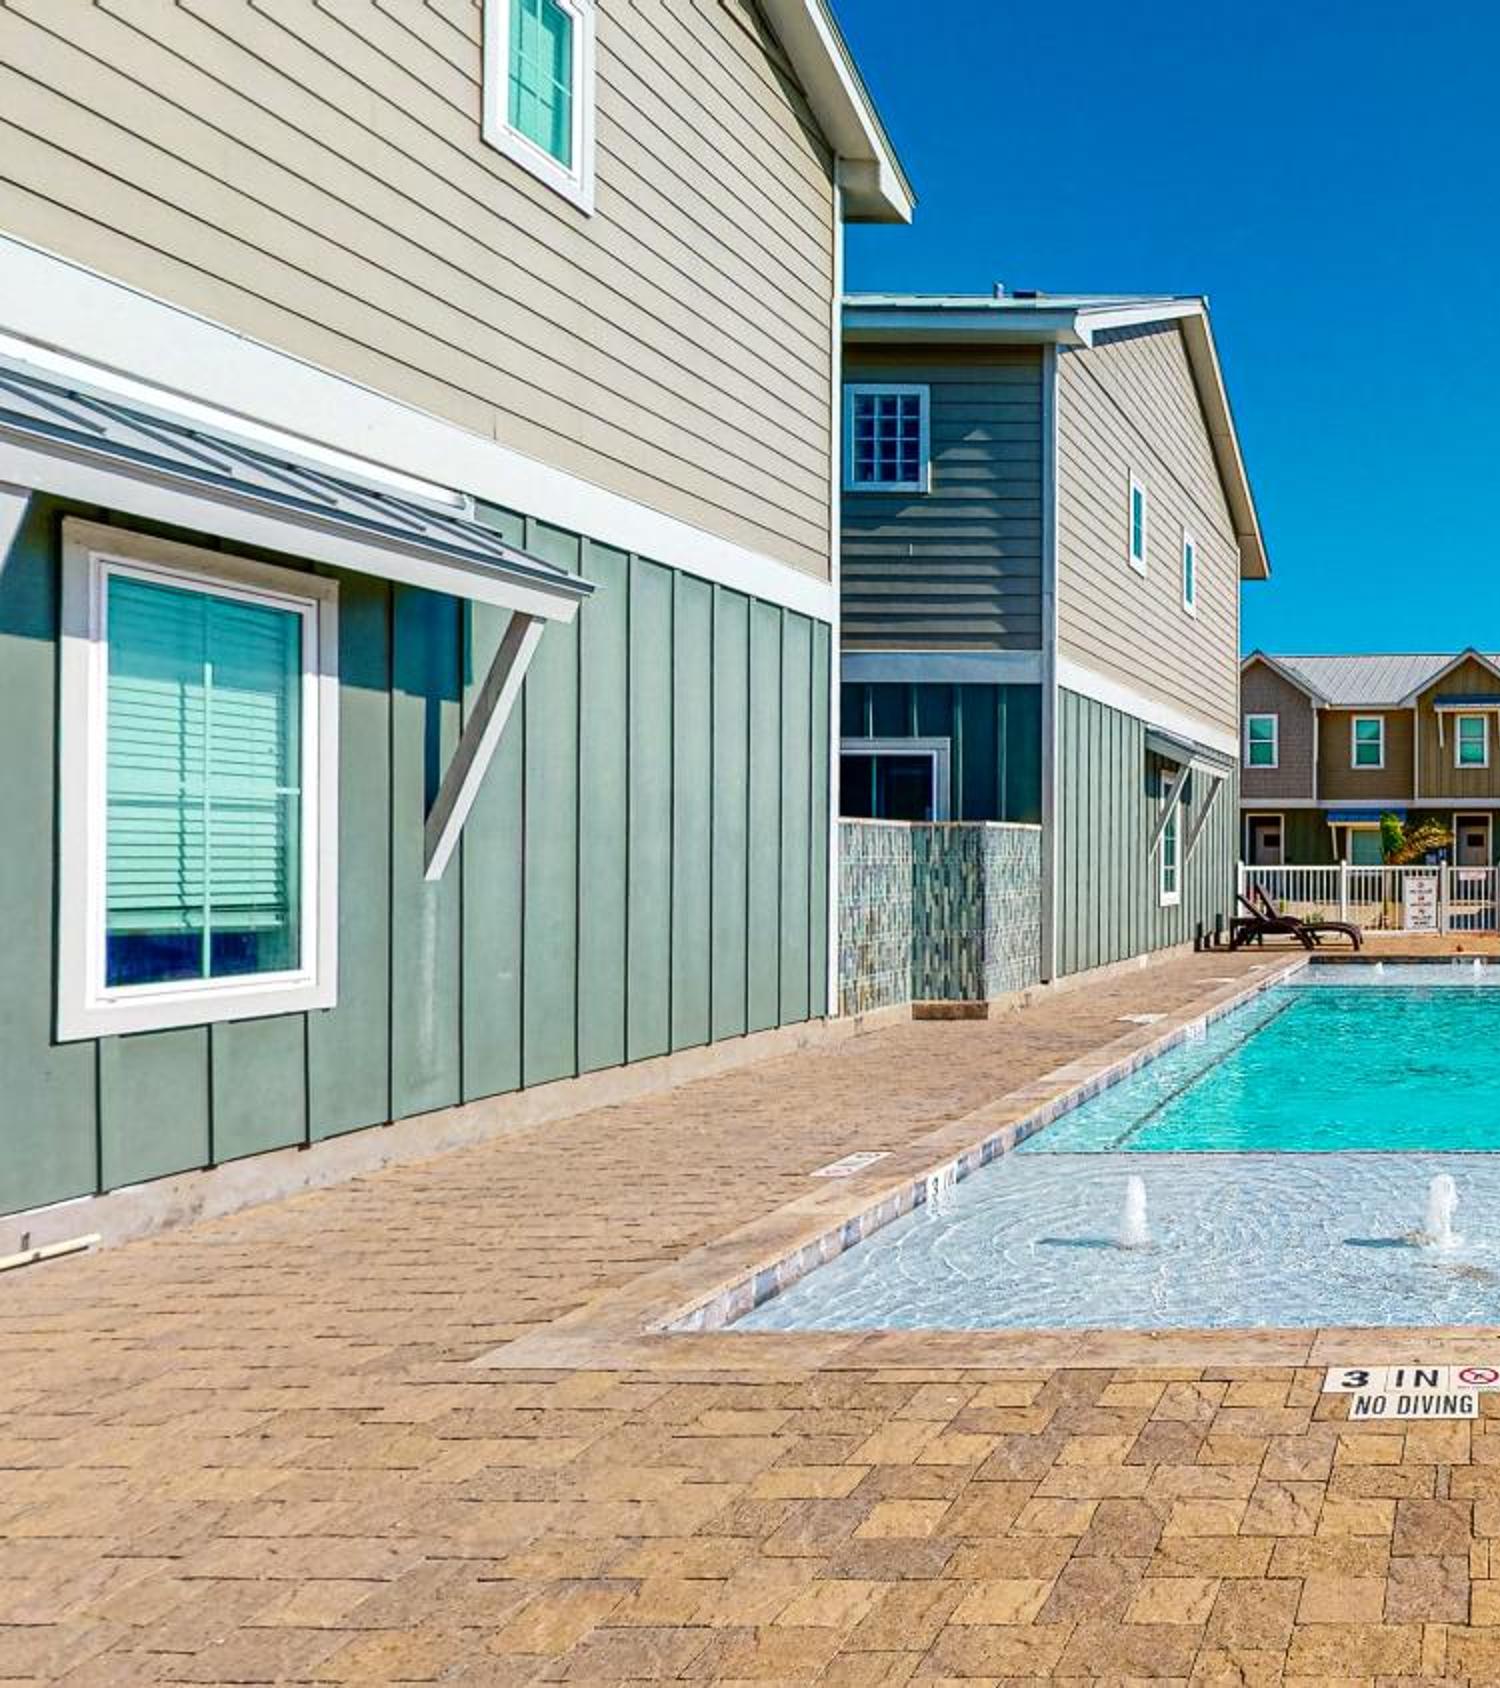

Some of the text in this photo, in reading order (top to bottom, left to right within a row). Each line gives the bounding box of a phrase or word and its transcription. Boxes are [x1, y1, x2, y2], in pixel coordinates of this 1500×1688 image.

[1341, 1369, 1439, 1388] 3 IN
[1354, 1395, 1473, 1415] NO DIVING
